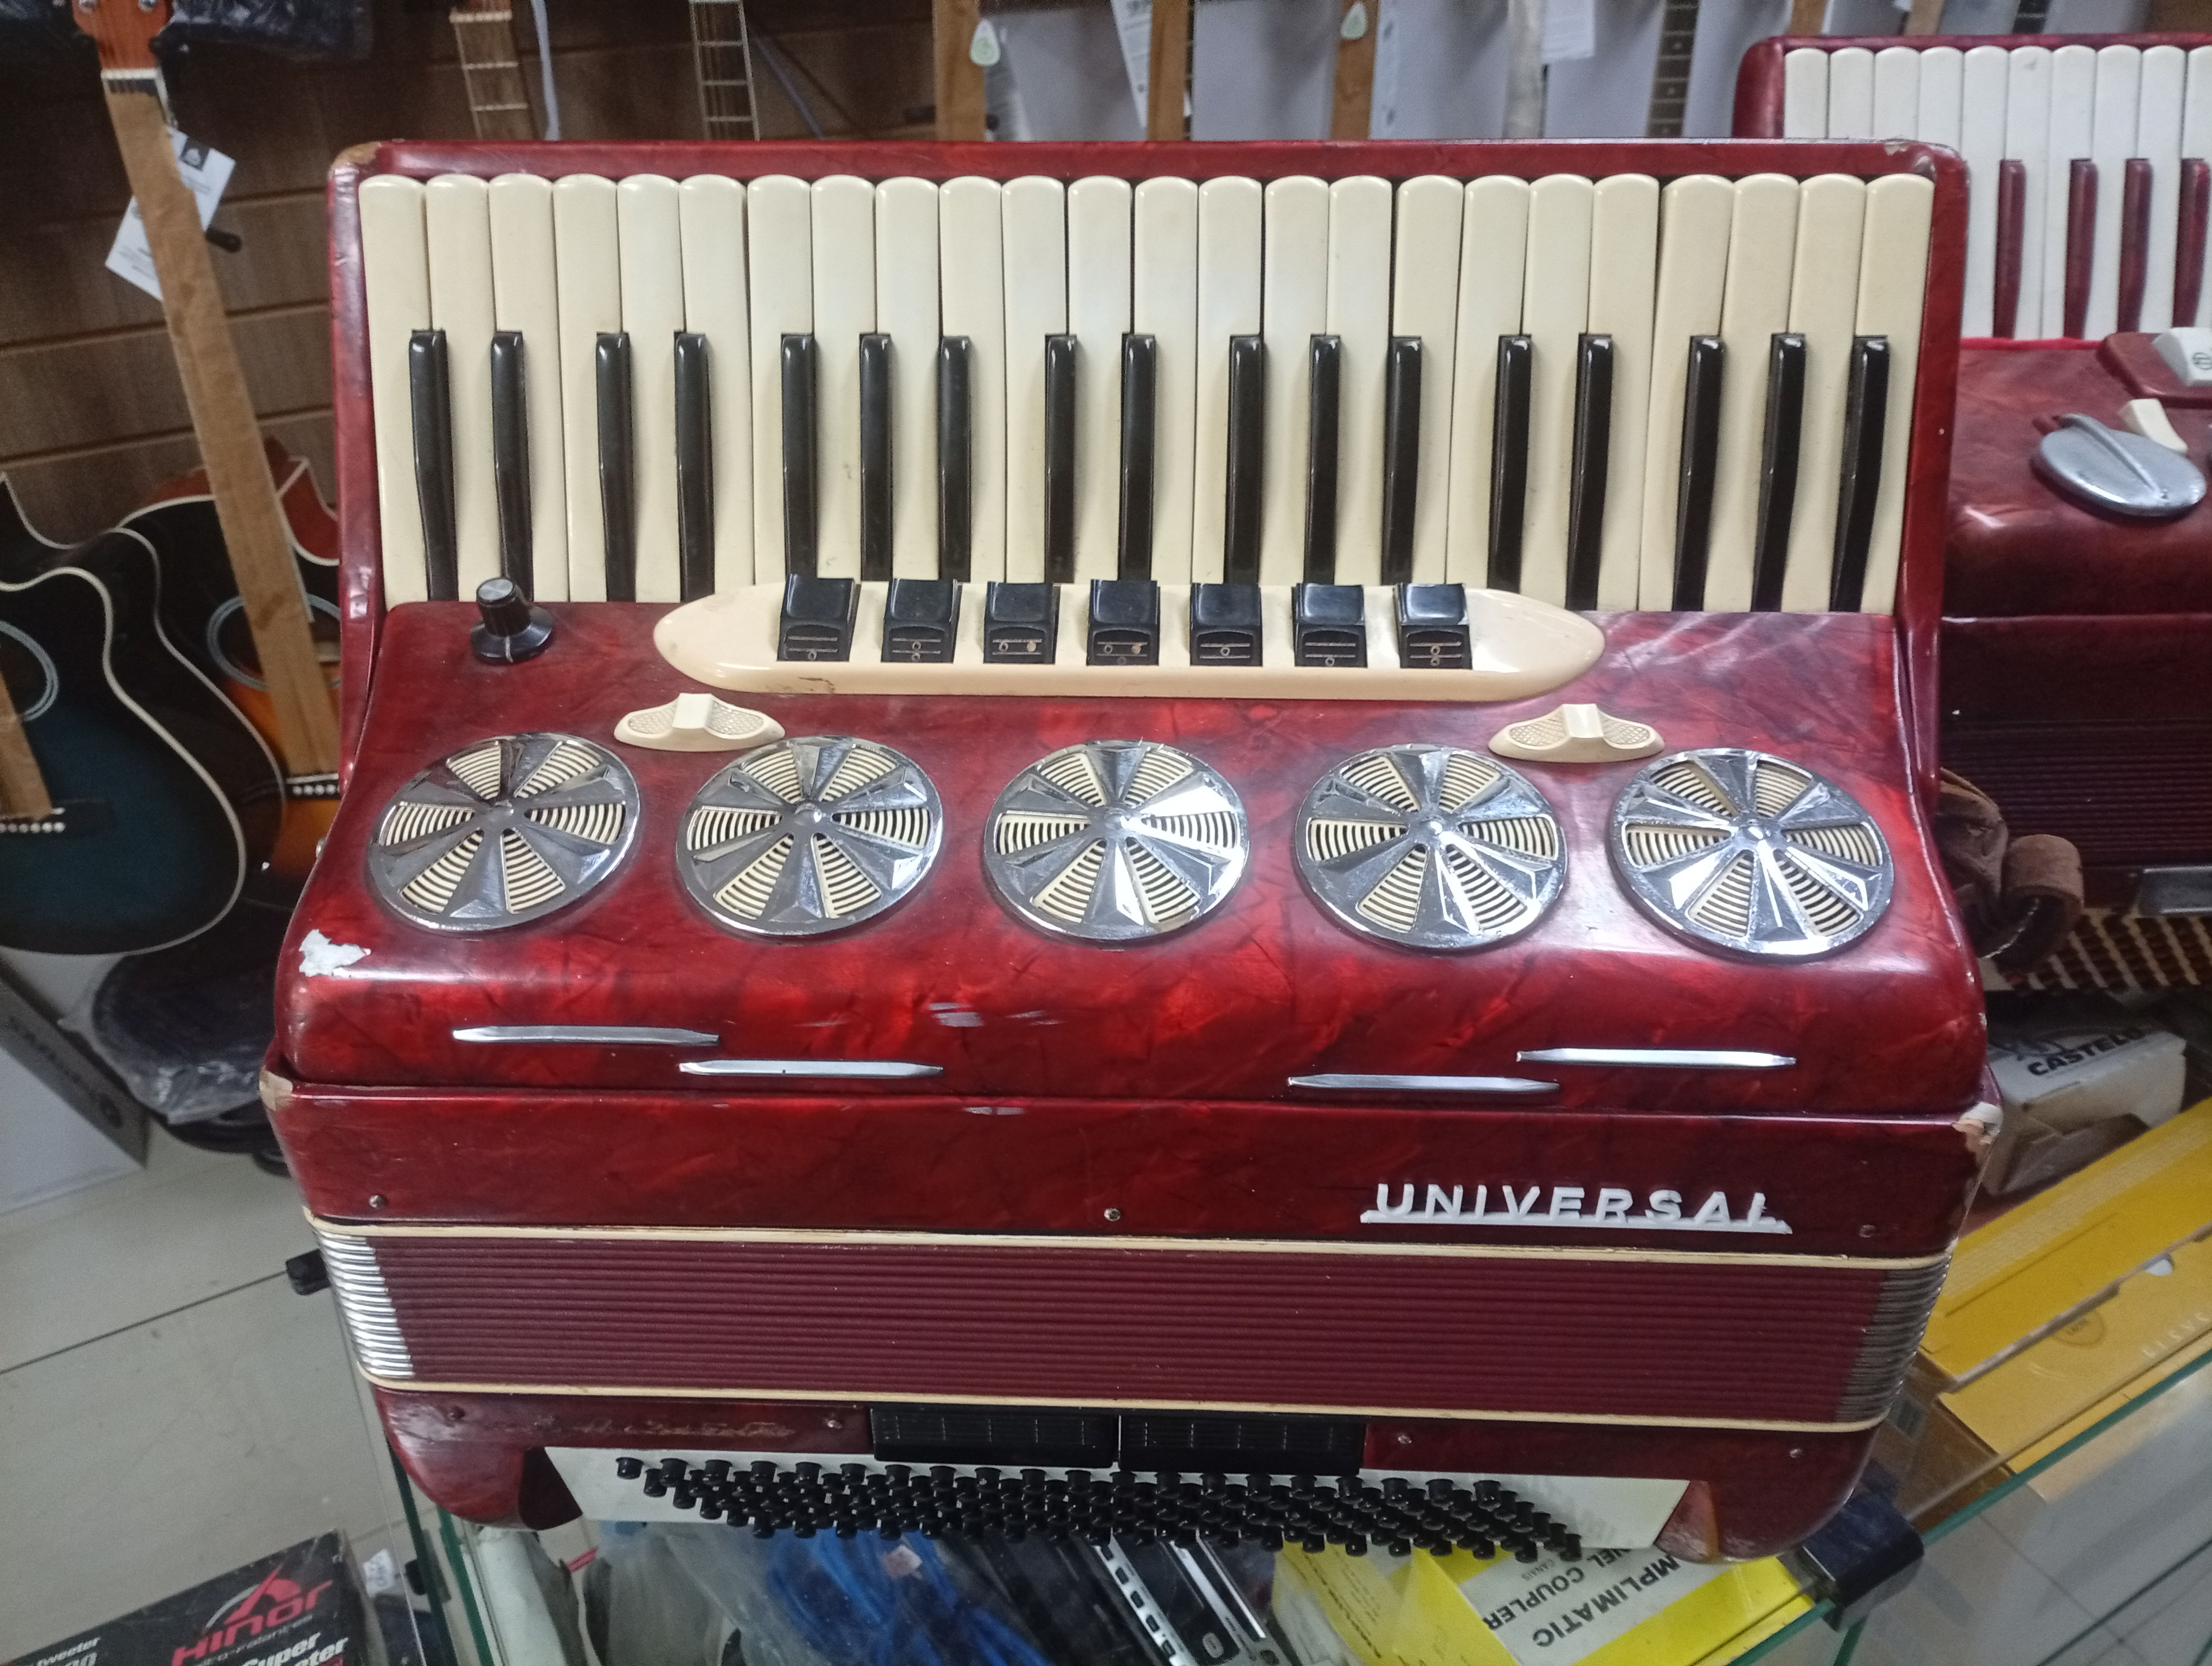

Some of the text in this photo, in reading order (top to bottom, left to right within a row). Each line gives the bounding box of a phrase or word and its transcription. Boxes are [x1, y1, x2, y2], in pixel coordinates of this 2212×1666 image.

[1372, 1182, 1785, 1231] UNIVERSAL
[1482, 1566, 1585, 1631] COUPLER
[1532, 1554, 1681, 1648] MPLIMATIC
